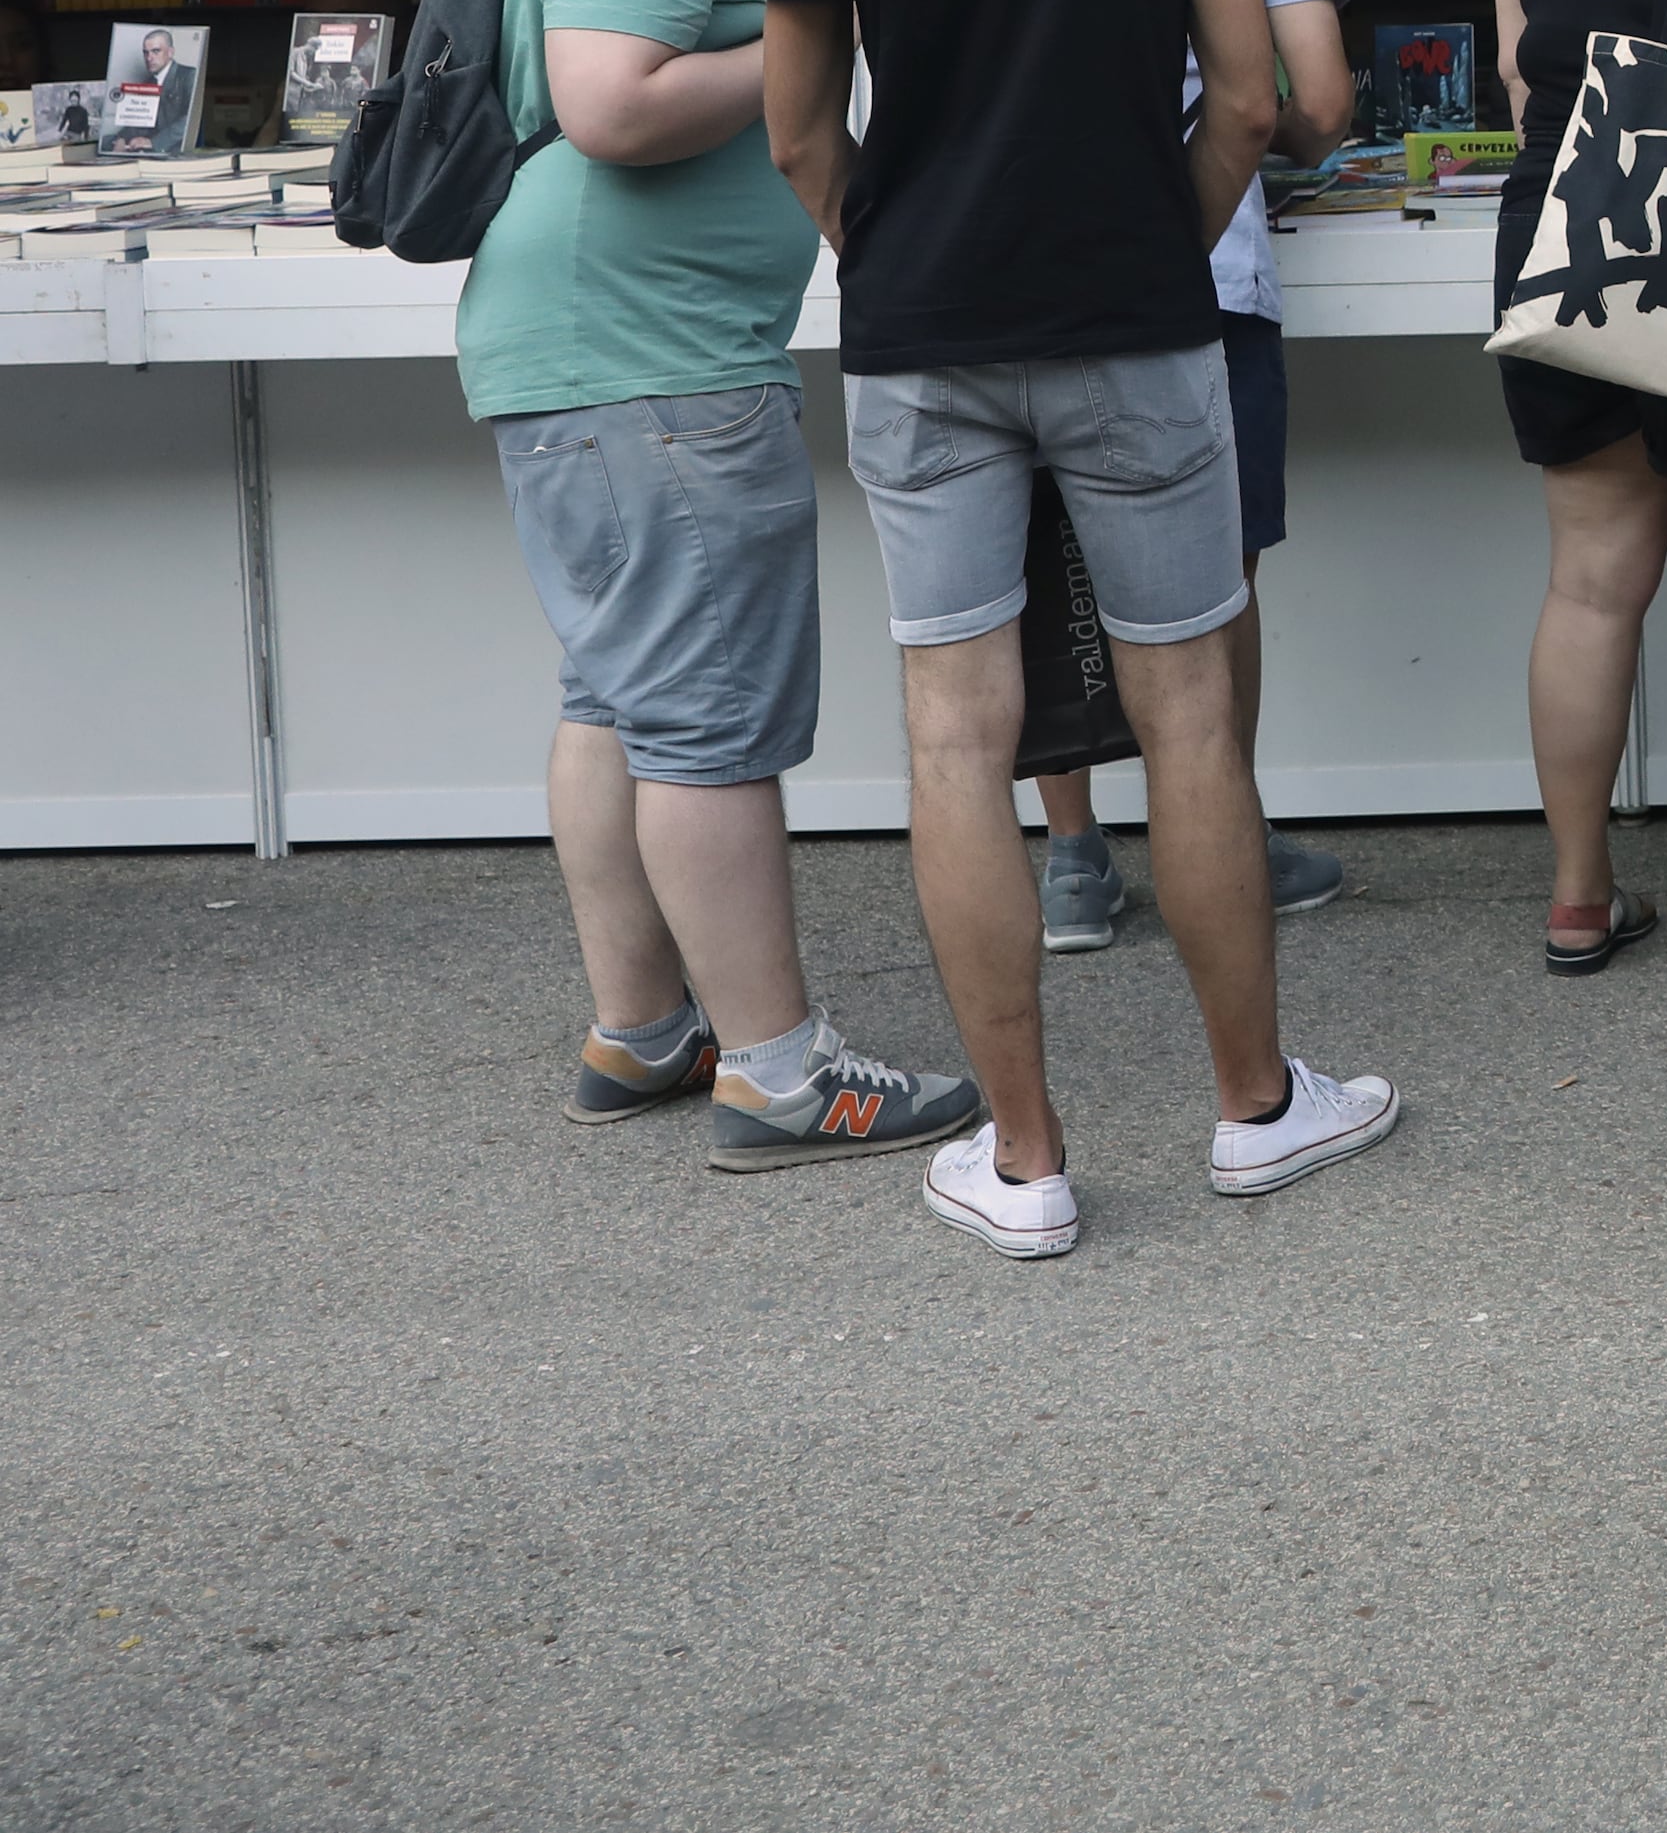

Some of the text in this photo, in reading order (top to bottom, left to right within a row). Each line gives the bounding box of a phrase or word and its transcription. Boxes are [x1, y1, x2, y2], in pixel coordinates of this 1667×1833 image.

[1460, 143, 1519, 153] CERVEZAS
[1058, 519, 1107, 701] valdemar
[818, 1088, 885, 1138] N
